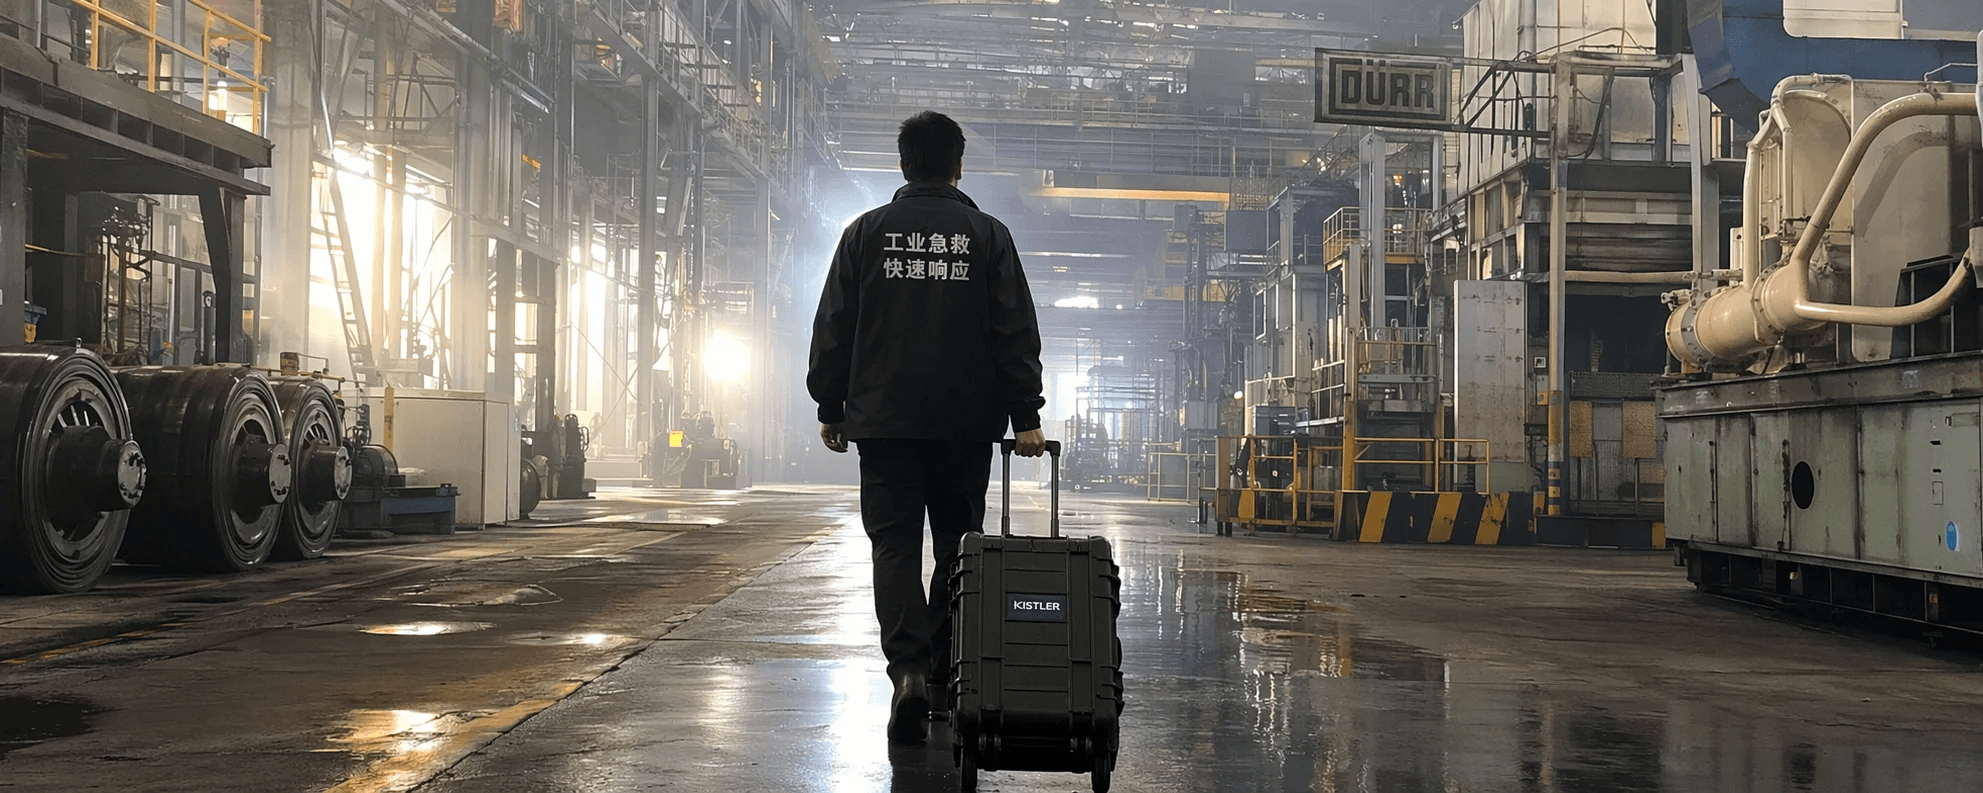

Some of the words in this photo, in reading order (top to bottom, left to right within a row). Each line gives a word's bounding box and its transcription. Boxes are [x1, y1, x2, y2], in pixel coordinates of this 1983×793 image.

[1341, 59, 1434, 108] DÜRR
[883, 232, 970, 254] 工业急救
[883, 257, 970, 281] 快速响应
[1013, 600, 1061, 611] KISTLER
